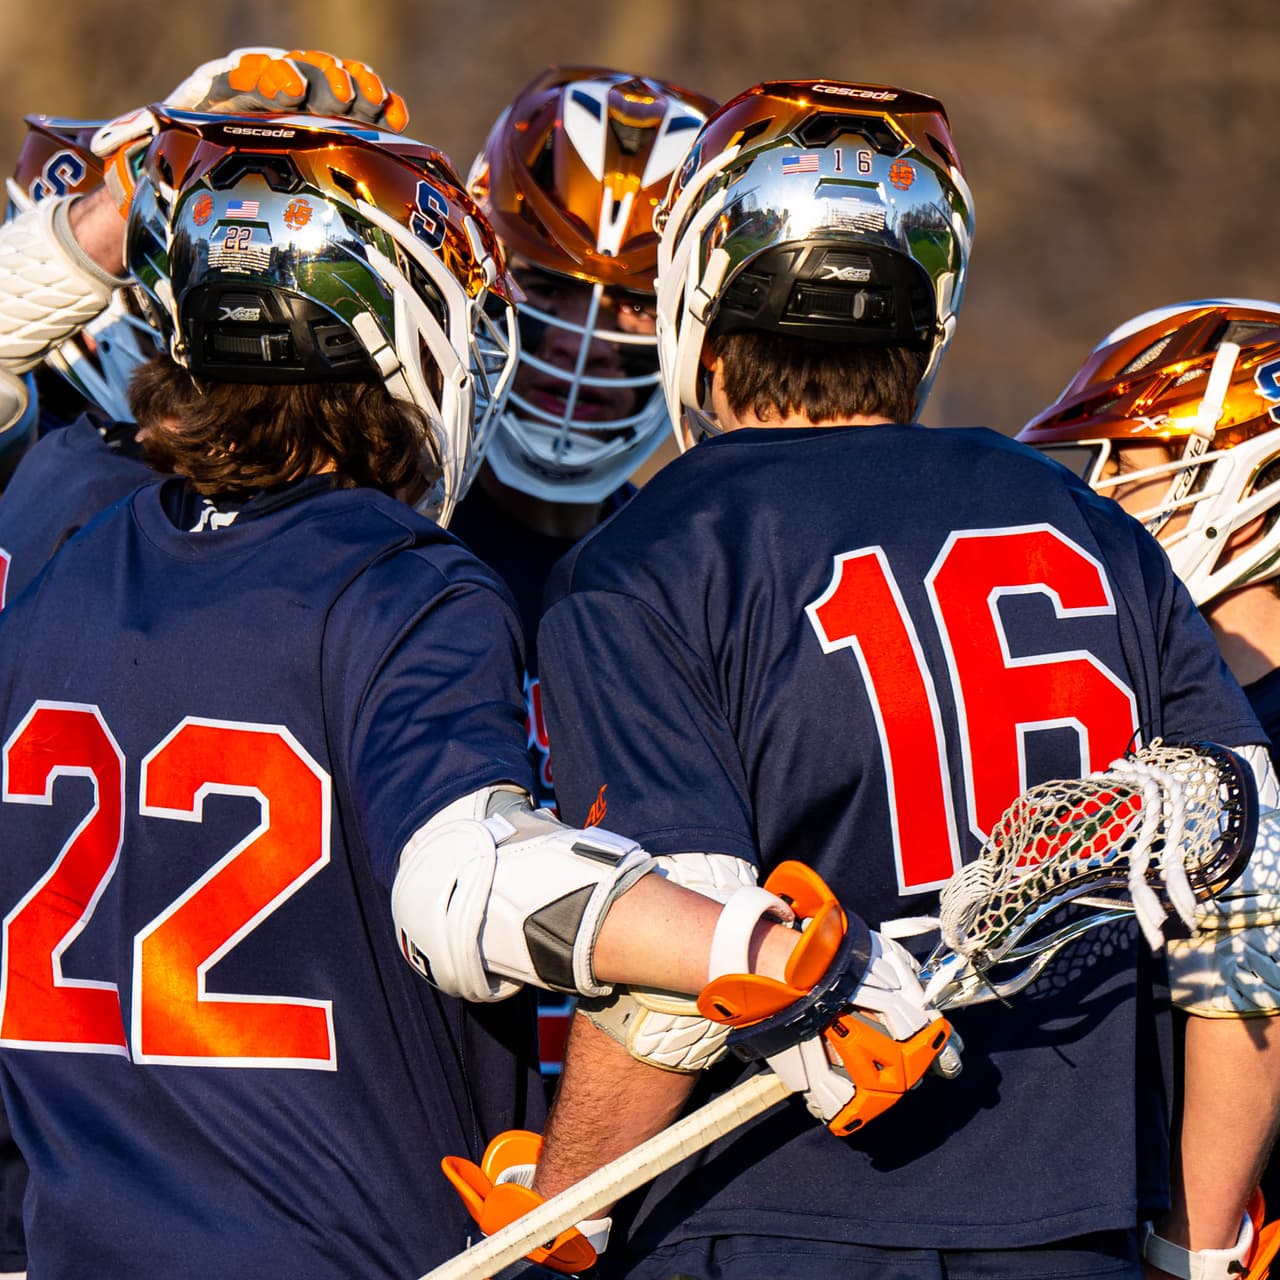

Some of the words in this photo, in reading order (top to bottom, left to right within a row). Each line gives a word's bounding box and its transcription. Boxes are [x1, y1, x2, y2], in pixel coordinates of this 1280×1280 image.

[812, 84, 898, 101] cascade
[223, 126, 296, 138] cascade
[409, 179, 450, 251] S
[224, 226, 253, 254] 22
[805, 522, 1142, 896] 16
